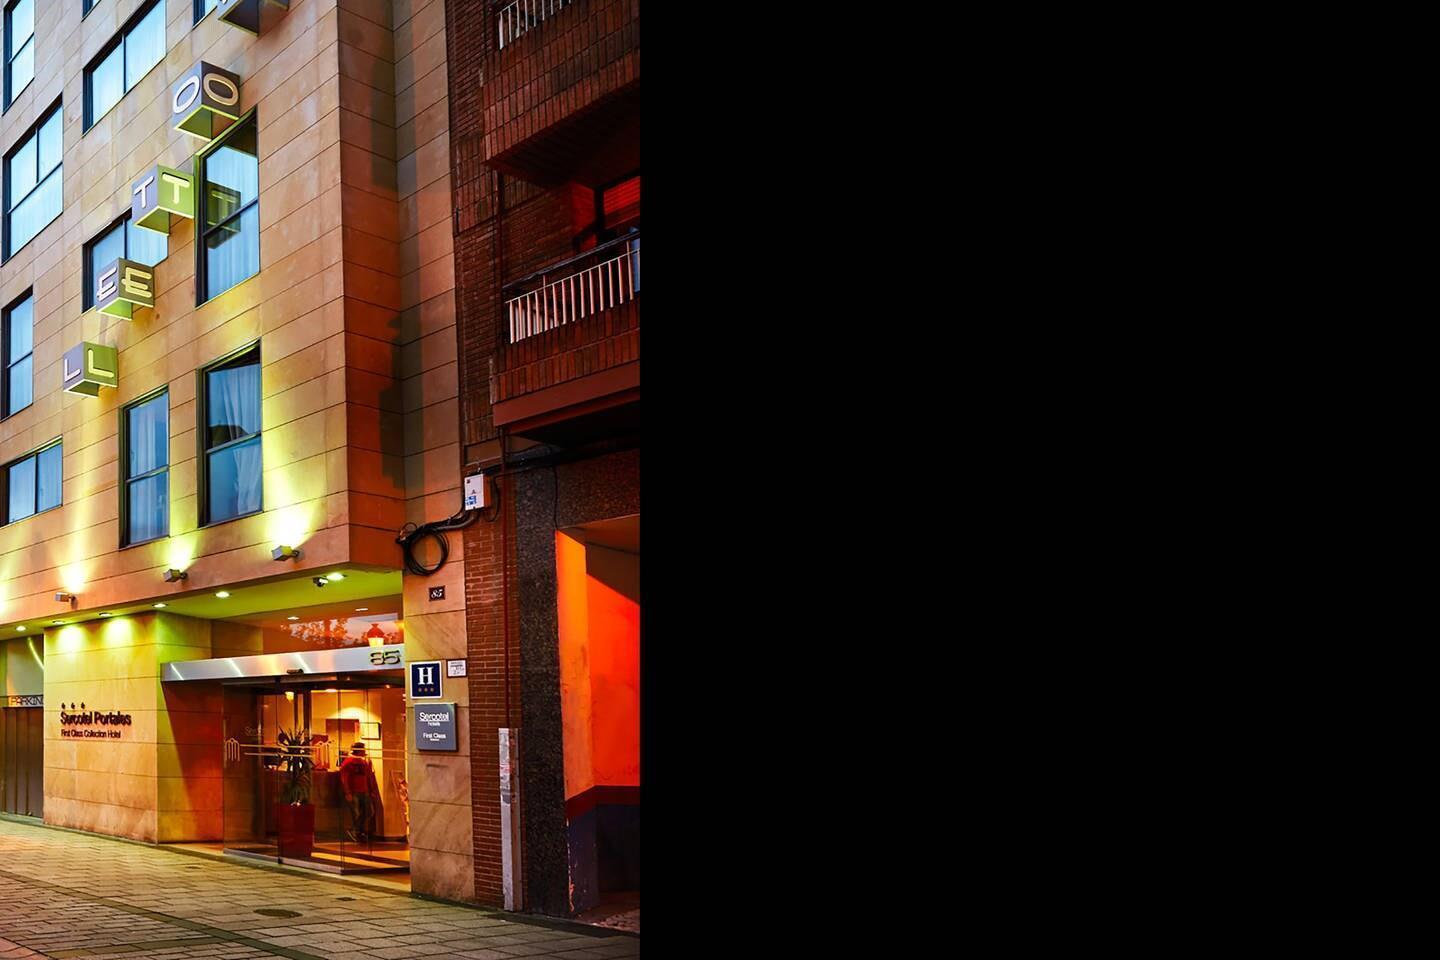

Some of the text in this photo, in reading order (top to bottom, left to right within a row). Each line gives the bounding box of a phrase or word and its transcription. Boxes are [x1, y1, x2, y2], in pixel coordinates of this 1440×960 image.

[431, 589, 443, 599] 85
[370, 650, 401, 666] 85
[417, 666, 434, 685] H
[94, 711, 132, 726] Portales
[419, 712, 449, 721] Sercotel
[107, 730, 121, 738] Hotel
